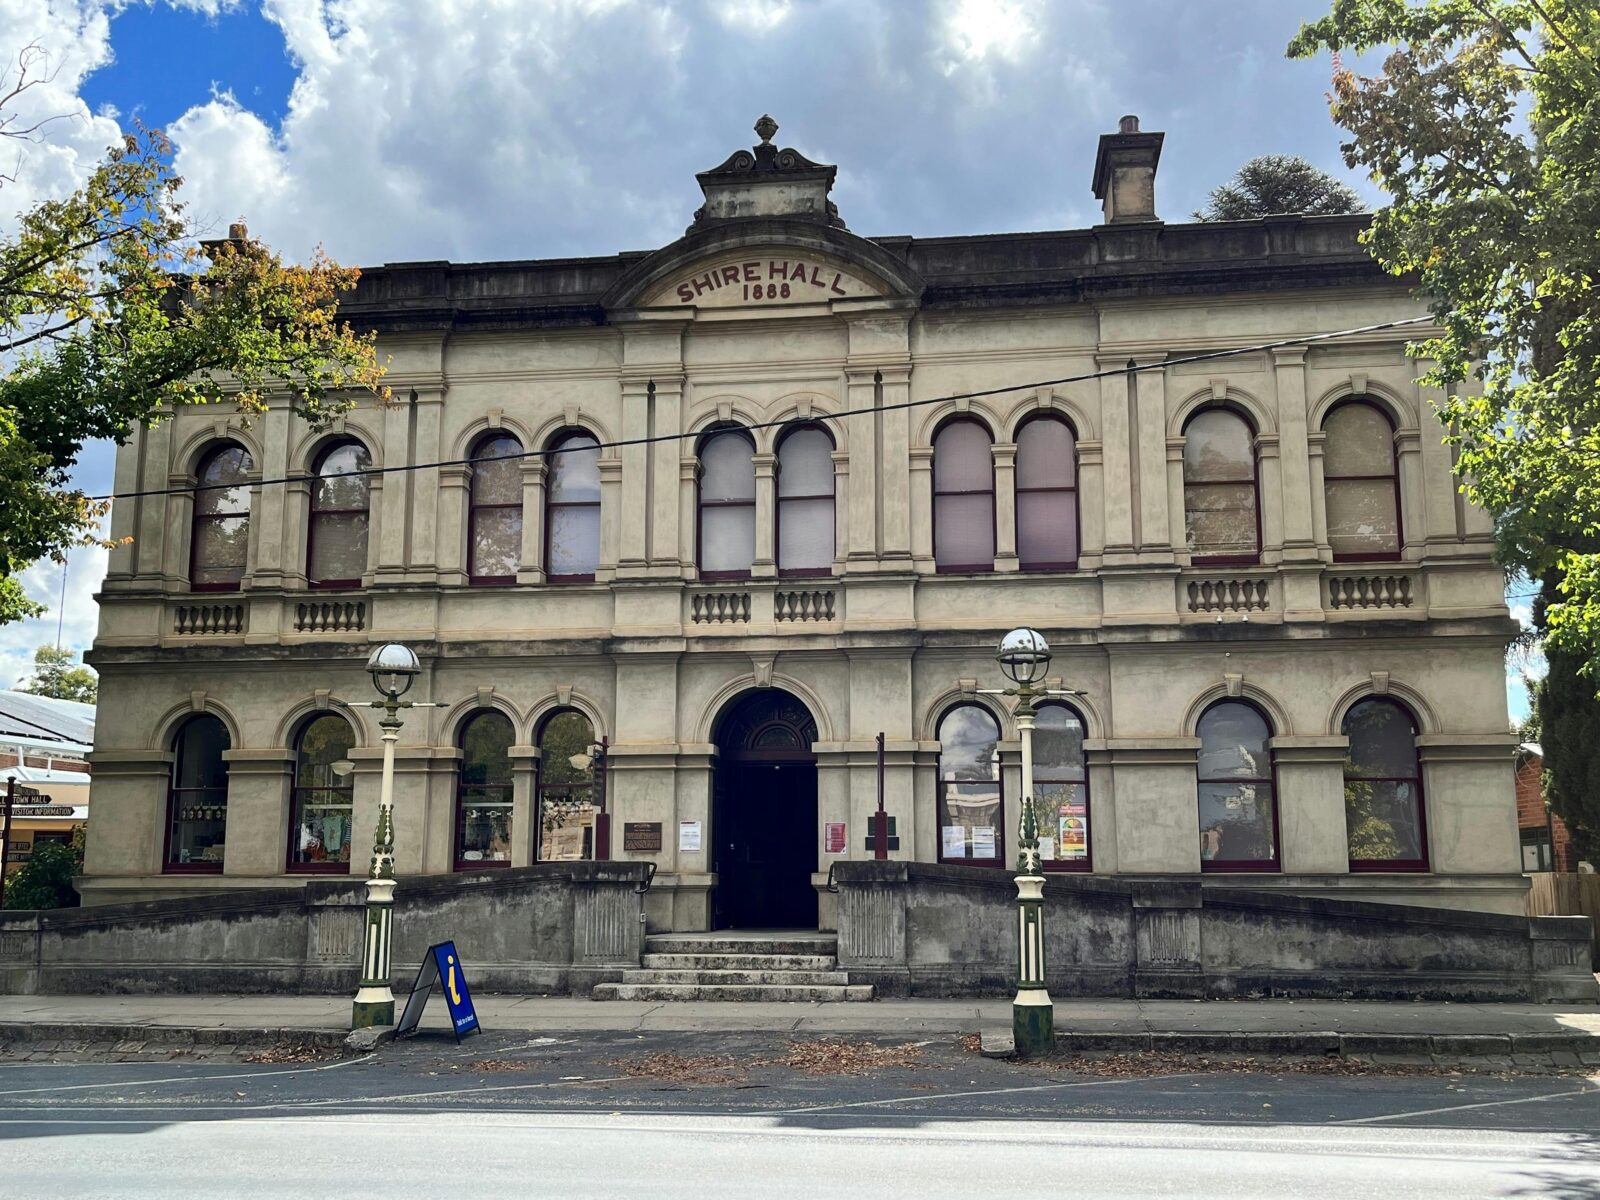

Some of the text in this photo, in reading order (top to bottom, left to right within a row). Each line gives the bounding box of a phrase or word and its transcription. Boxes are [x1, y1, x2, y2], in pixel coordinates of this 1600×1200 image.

[676, 261, 846, 303] SHIRE HALL
[743, 283, 791, 301] 1888
[13, 796, 29, 804] TOWN
[31, 796, 47, 804] HALL
[12, 807, 34, 816] VISITOR
[34, 807, 71, 815] INFORMATION
[448, 955, 461, 1005] i
